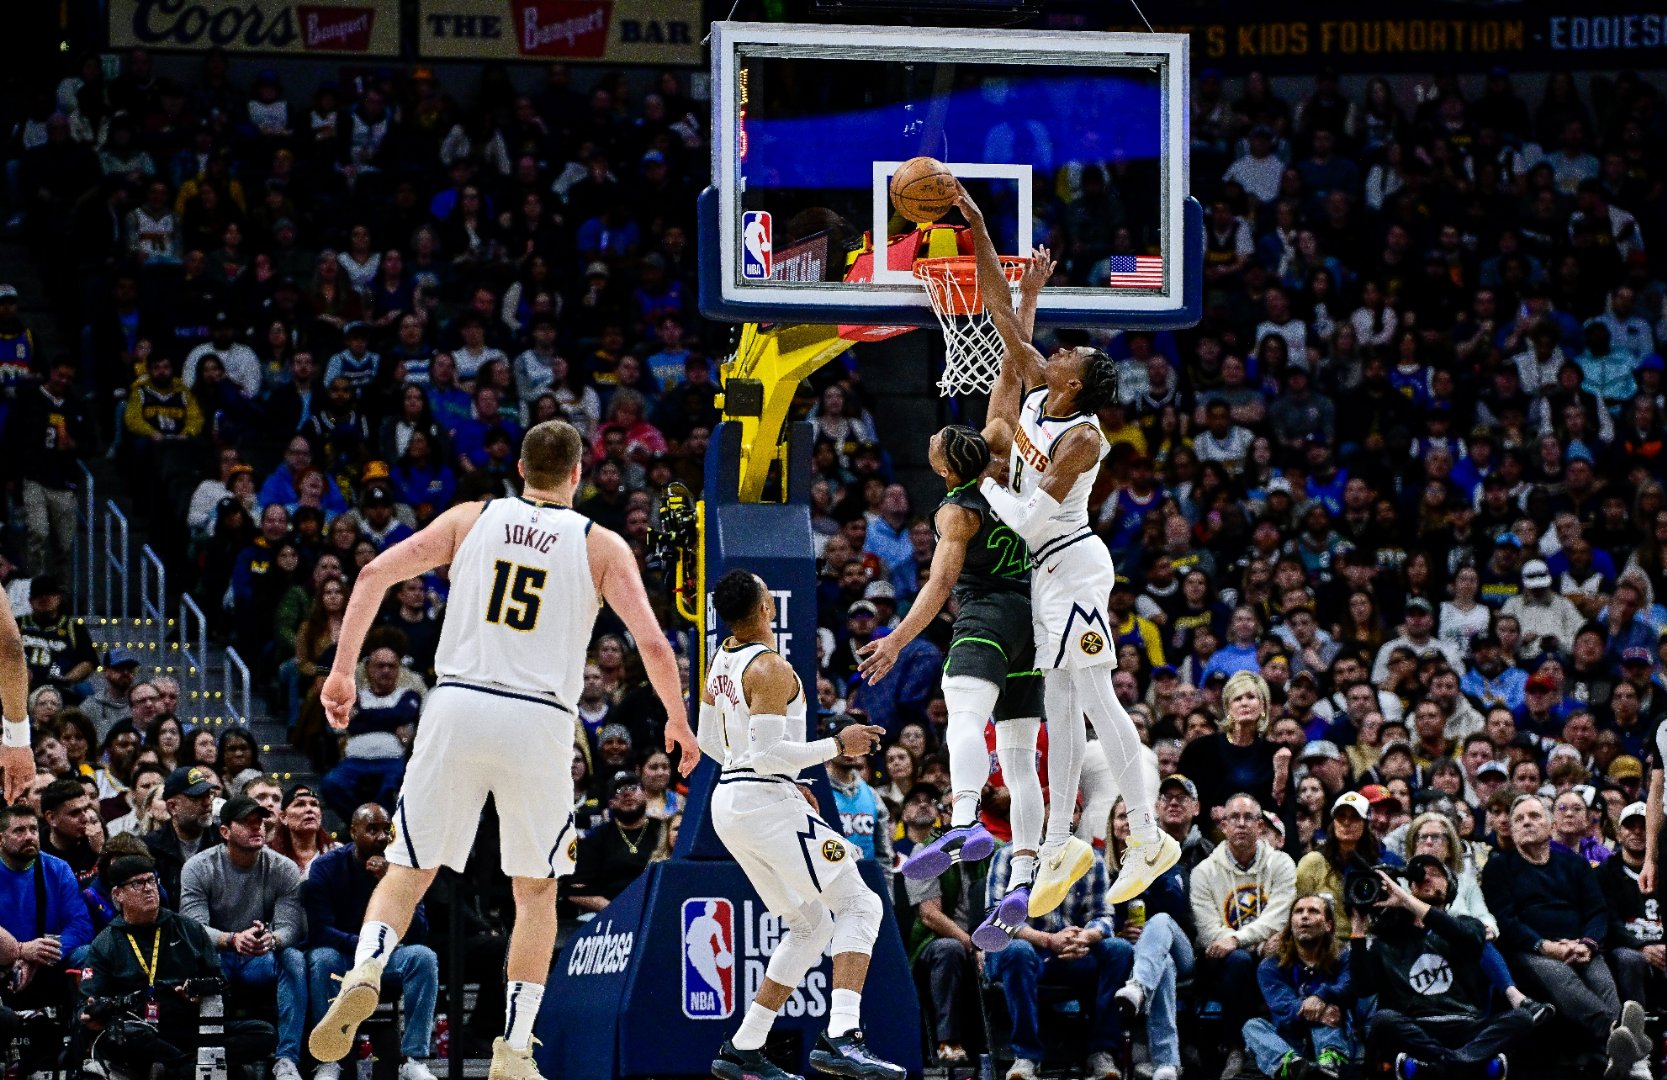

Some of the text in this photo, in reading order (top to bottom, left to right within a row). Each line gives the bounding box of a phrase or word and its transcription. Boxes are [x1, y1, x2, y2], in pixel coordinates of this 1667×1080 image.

[133, 0, 297, 46] Coors
[428, 14, 502, 39] THE
[620, 20, 691, 45] BAR
[1235, 20, 1311, 57] KIDS
[1318, 17, 1525, 56] FOUNDATION
[747, 263, 761, 275] NBA
[504, 524, 559, 554] JOKIĆ
[485, 558, 548, 632] 15
[722, 712, 730, 748] 1
[567, 919, 633, 976] coinbase
[690, 991, 716, 1012] NBA
[744, 959, 827, 1018] Pss
